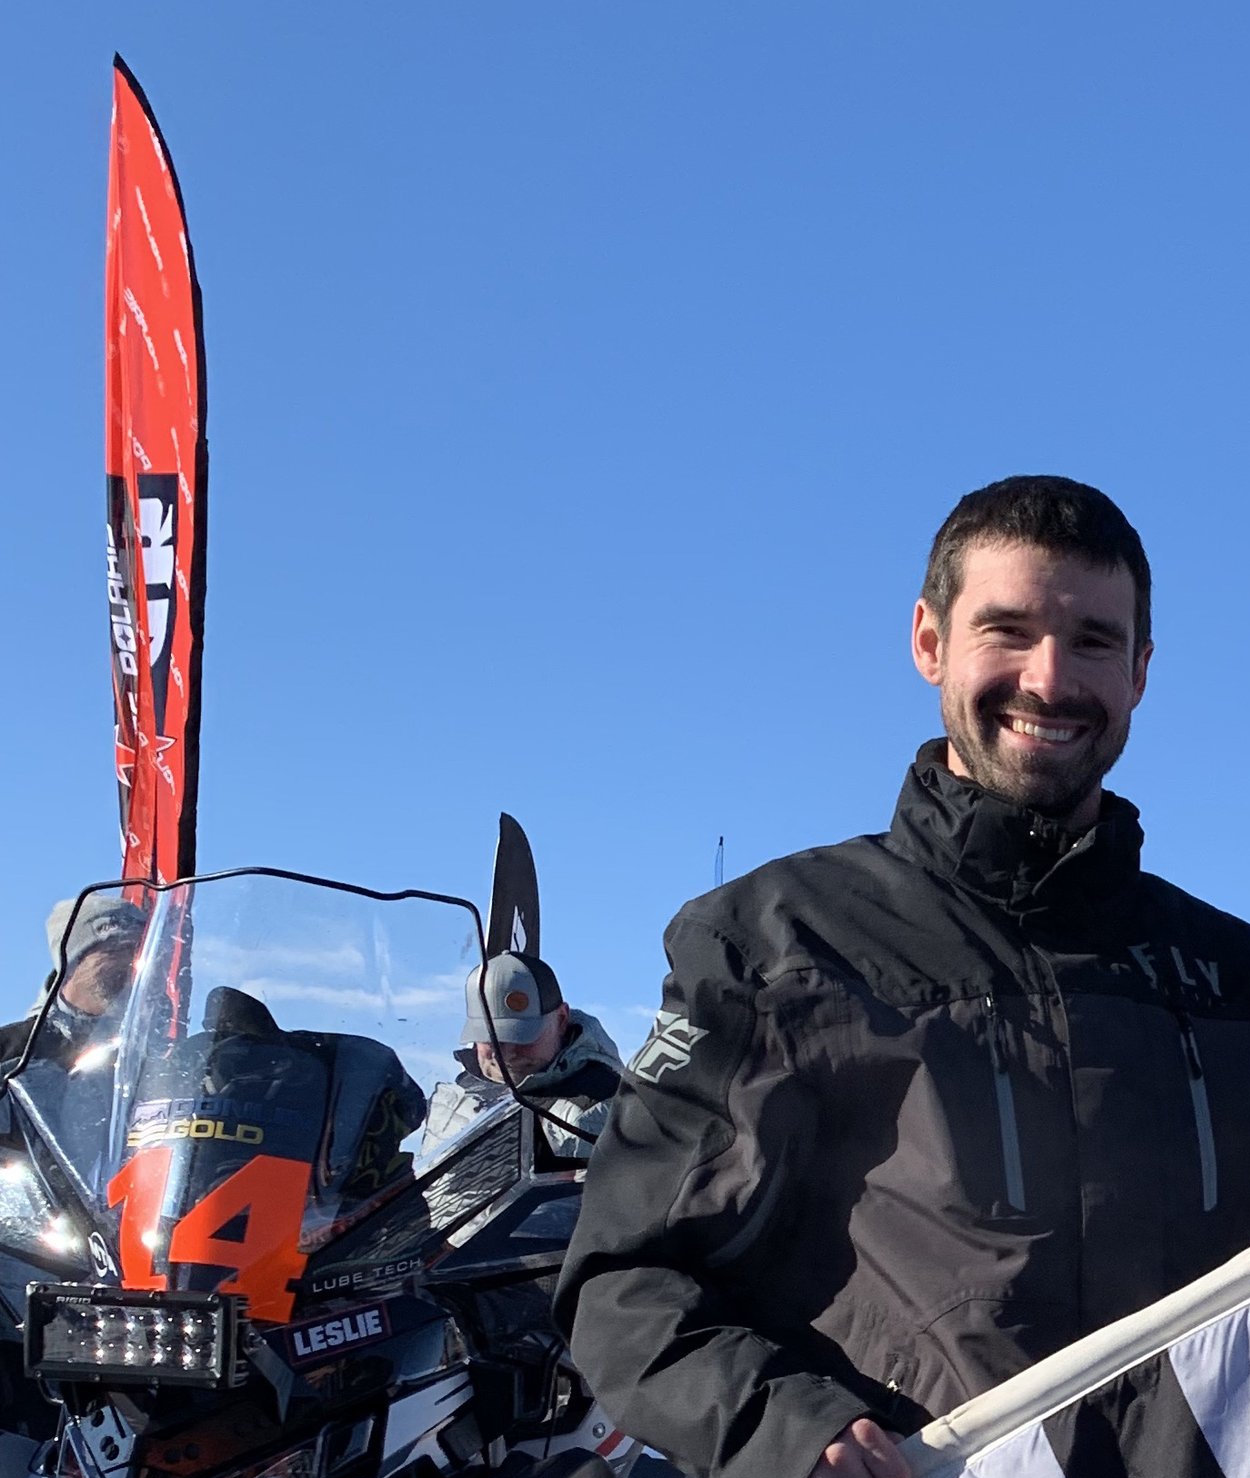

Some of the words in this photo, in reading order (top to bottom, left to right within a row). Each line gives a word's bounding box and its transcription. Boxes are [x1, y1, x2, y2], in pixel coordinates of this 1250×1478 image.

[165, 1119, 264, 1145] GOLD
[106, 1146, 312, 1324] 14
[312, 1271, 363, 1293] LUBE
[373, 1257, 422, 1279] TECH
[293, 1309, 383, 1357] LESLIE
